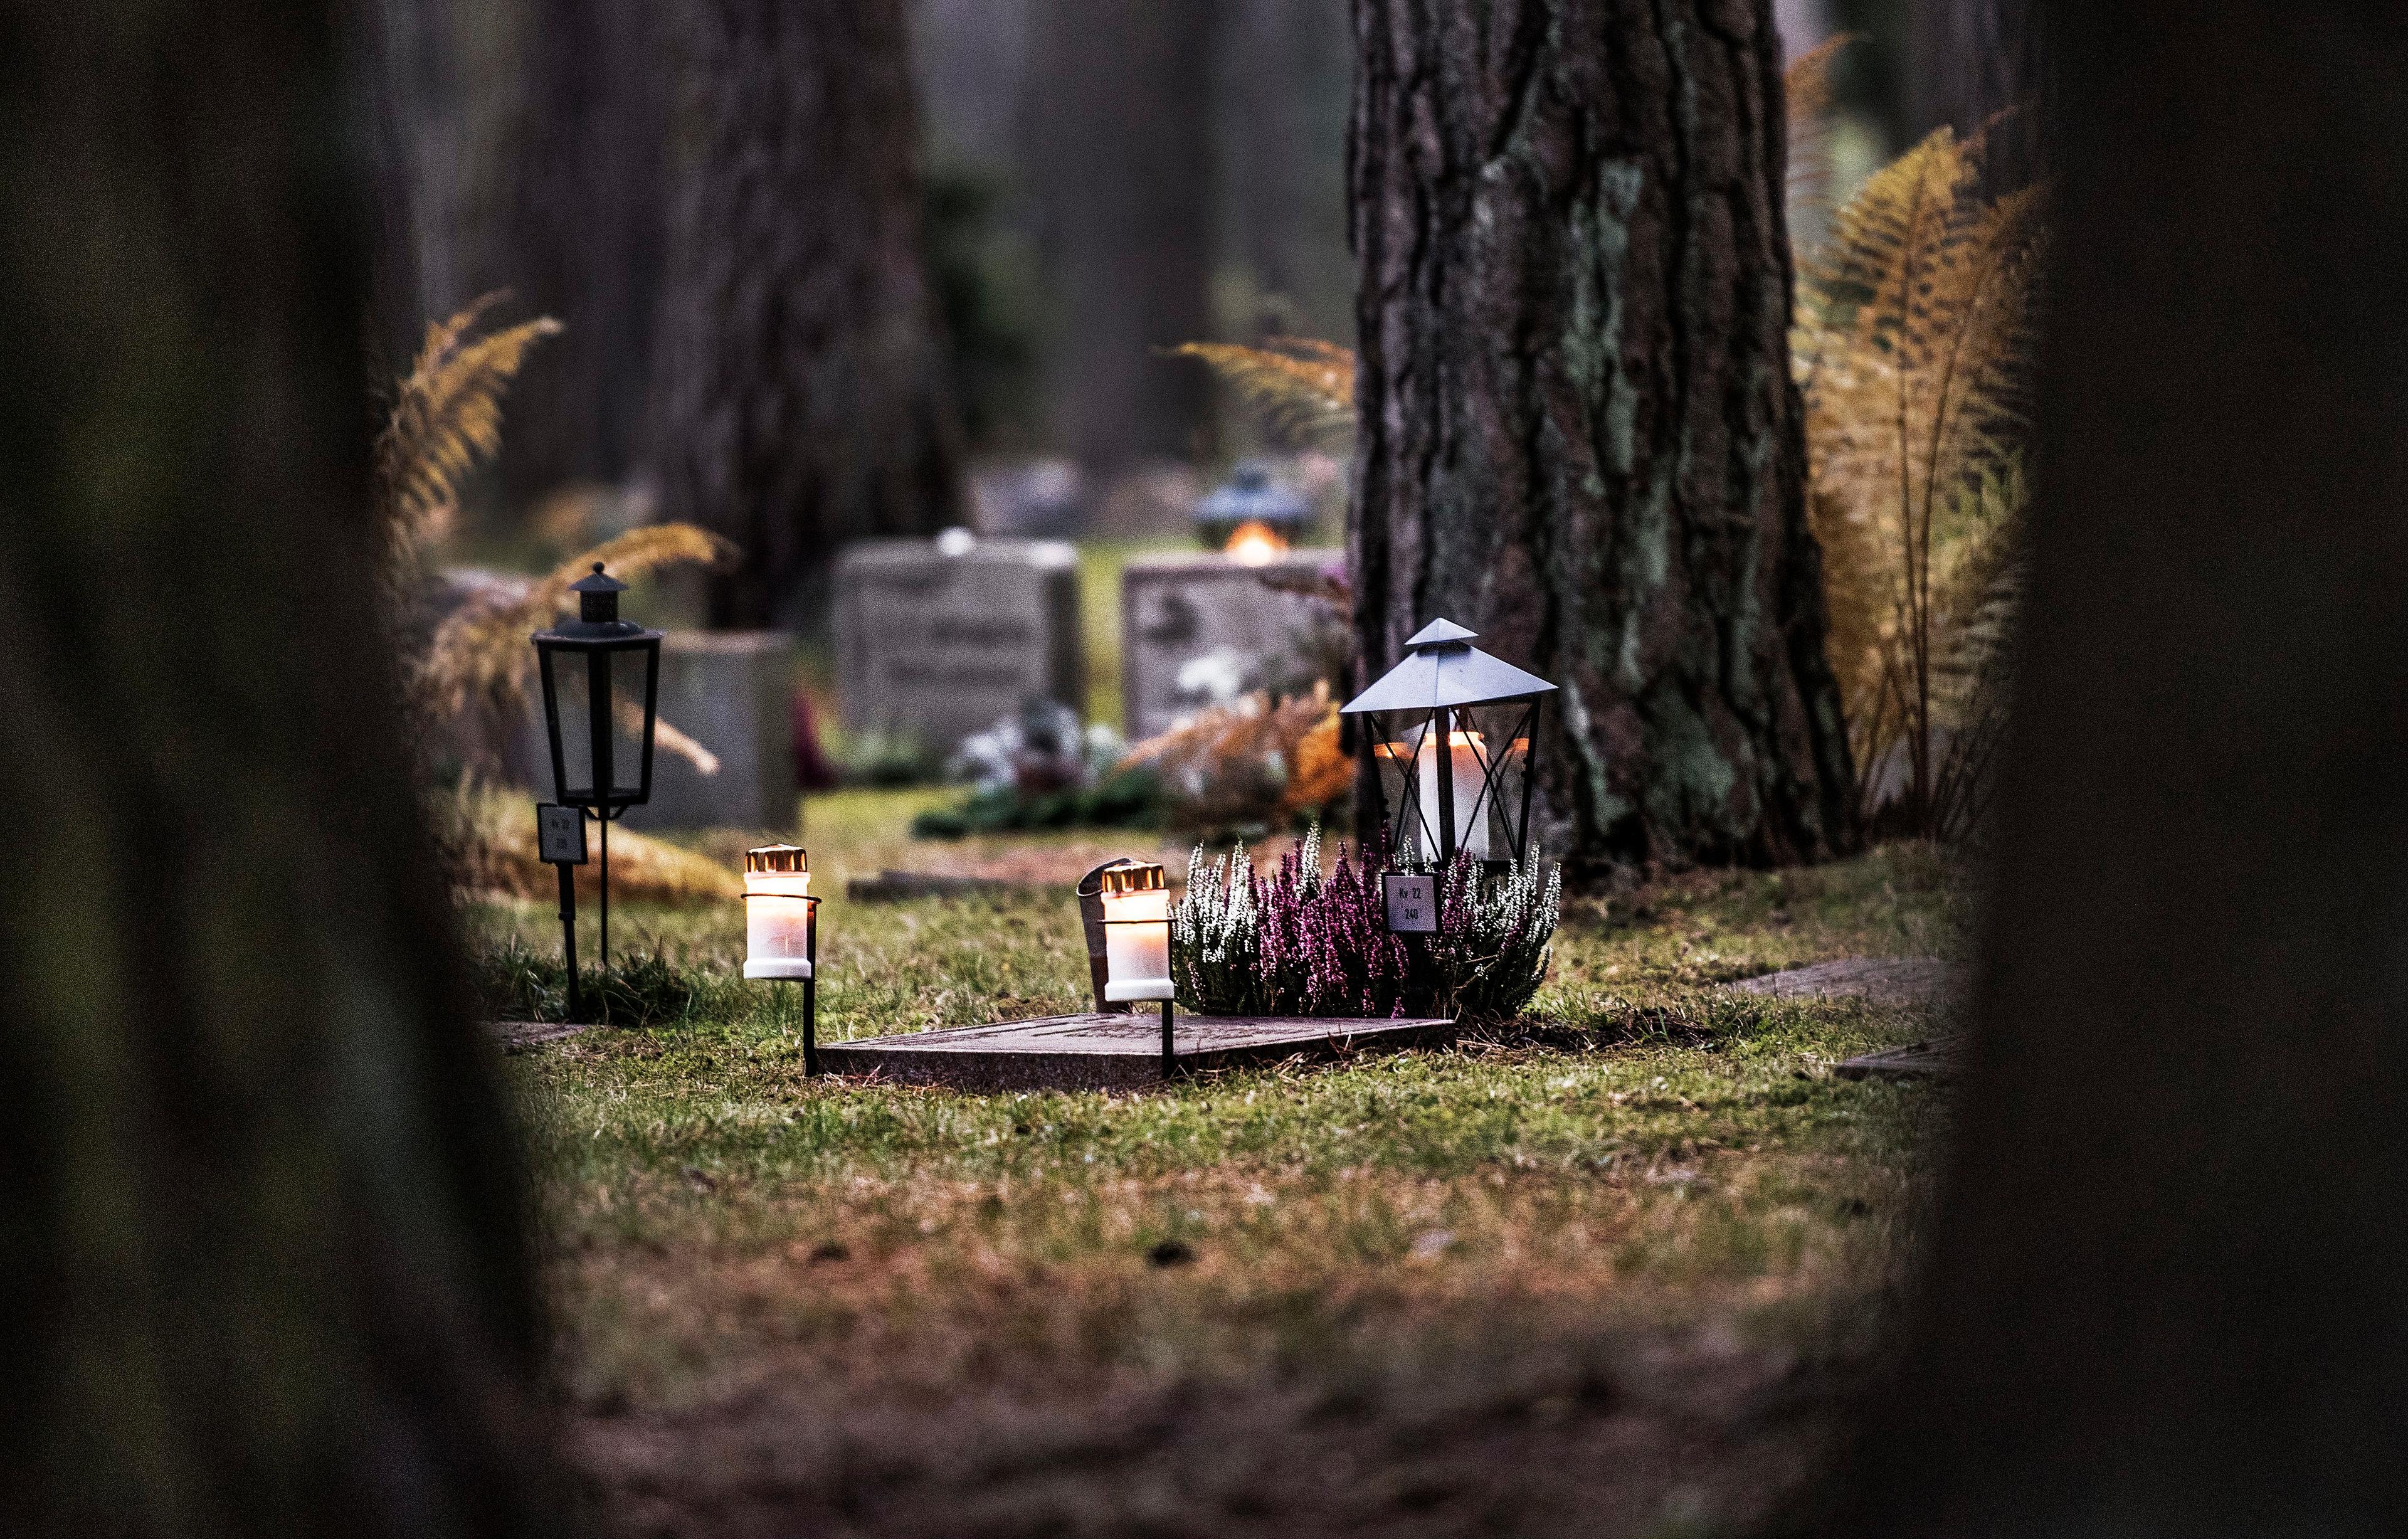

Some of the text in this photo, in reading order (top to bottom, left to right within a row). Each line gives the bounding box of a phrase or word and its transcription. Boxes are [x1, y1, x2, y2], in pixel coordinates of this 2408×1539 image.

[1399, 887, 1422, 899] Kv 22
[1405, 908, 1418, 920] 240
